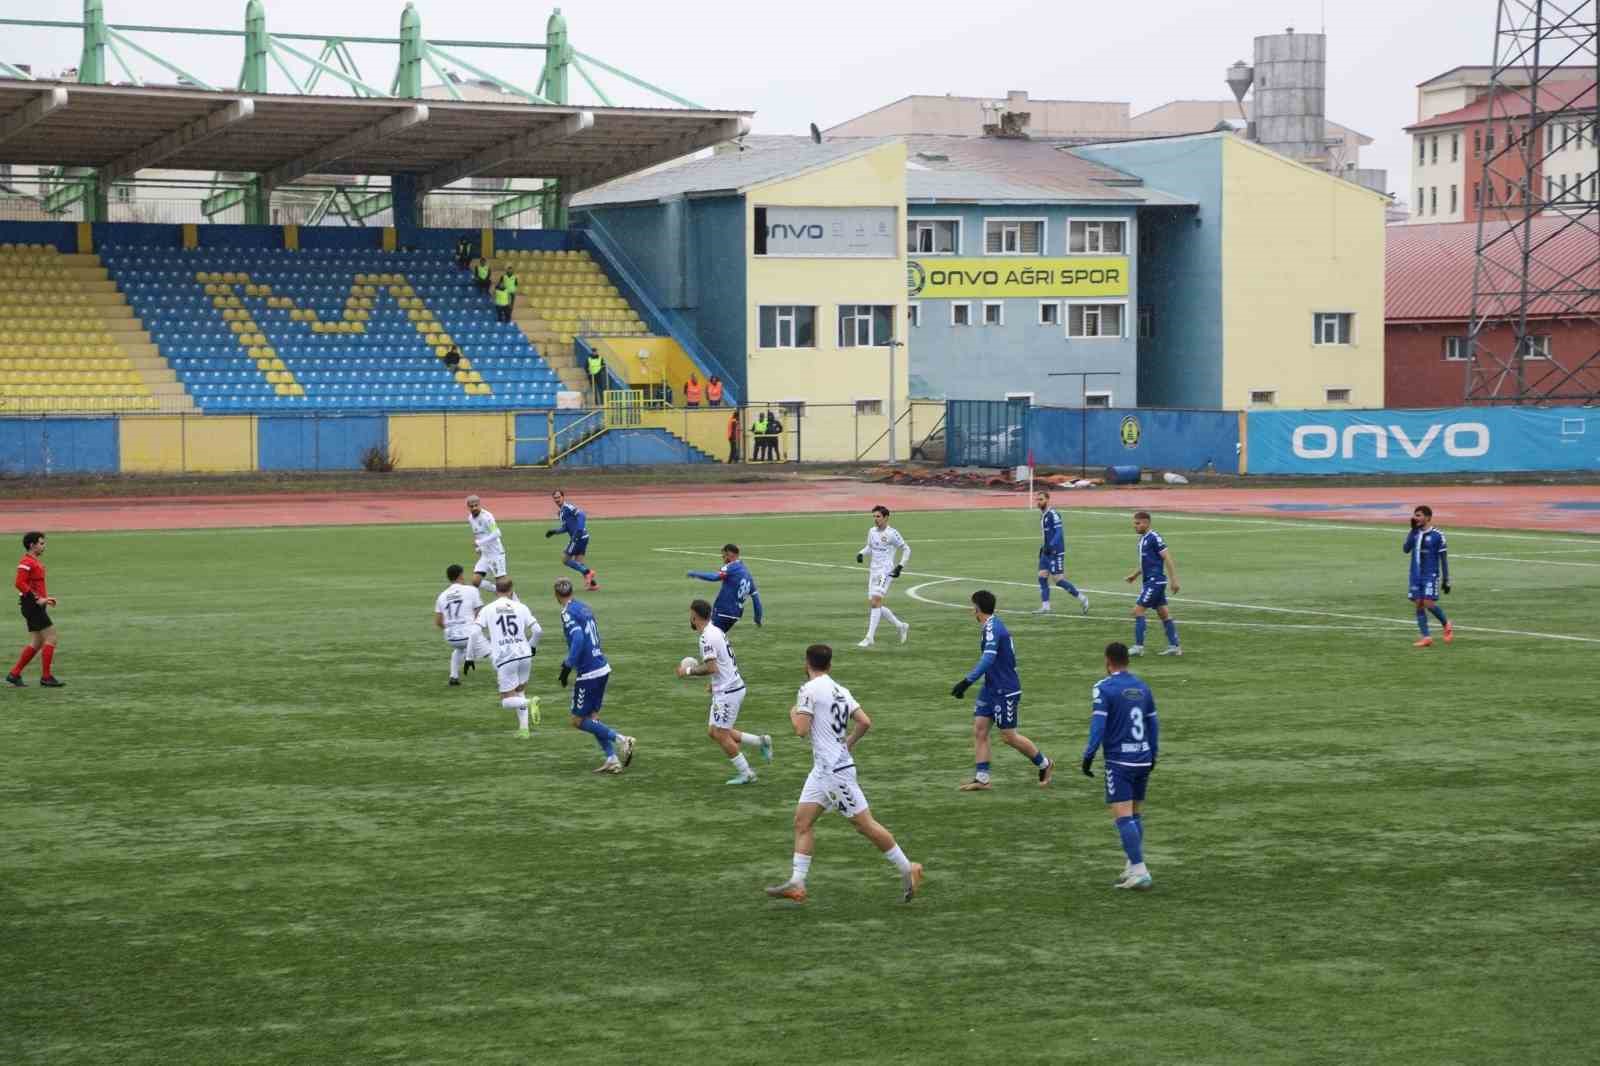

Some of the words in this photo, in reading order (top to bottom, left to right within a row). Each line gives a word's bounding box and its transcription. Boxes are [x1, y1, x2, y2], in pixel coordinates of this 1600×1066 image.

[1004, 267, 1054, 285] AĞRI
[1060, 268, 1120, 284] SPOR
[444, 599, 463, 620] 17
[496, 614, 519, 637] 15
[1130, 706, 1144, 741] 3
